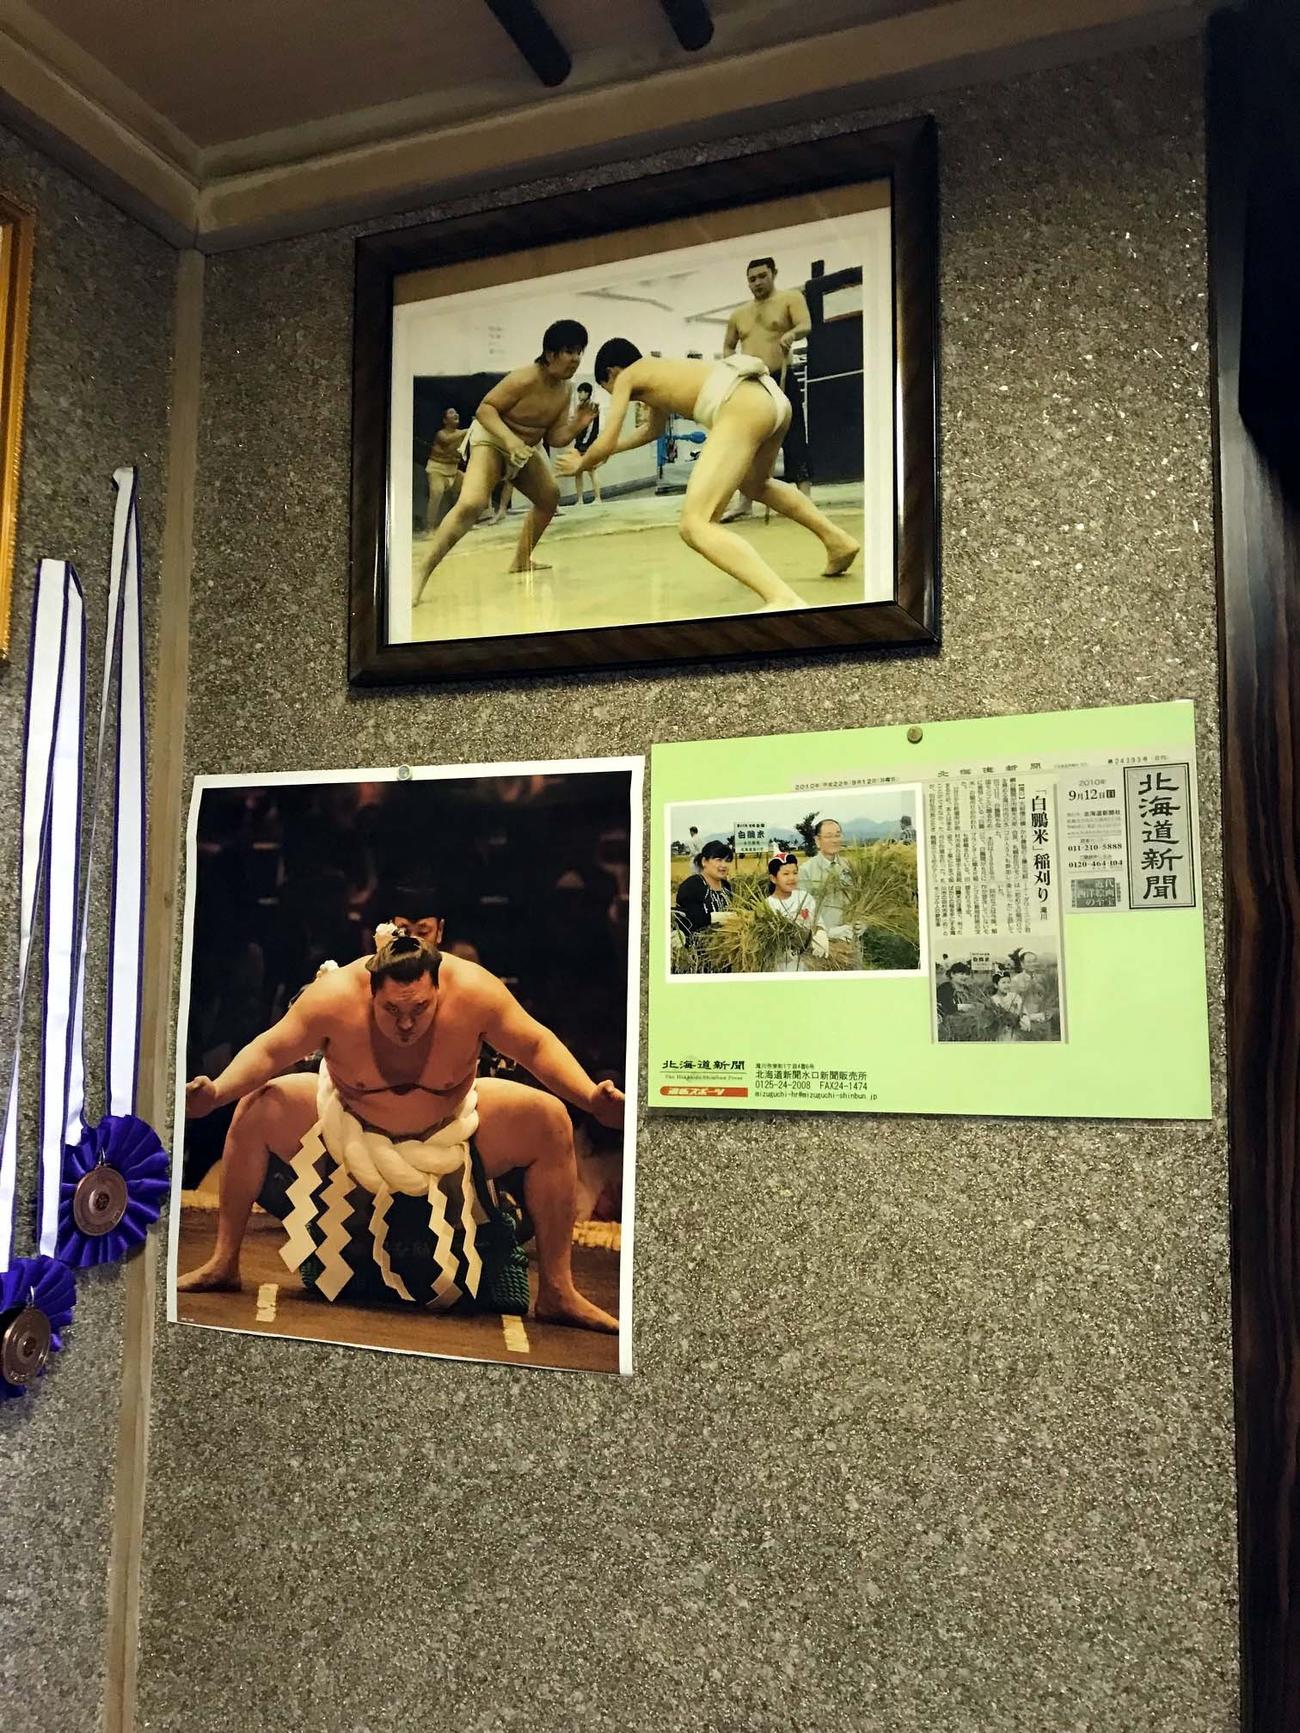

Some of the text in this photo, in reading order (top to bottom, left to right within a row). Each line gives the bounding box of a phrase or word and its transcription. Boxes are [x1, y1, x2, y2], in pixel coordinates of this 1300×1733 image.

[1138, 772, 1183, 900] 北海道新聞
[662, 1060, 745, 1070] 北海道新聞
[755, 1080, 868, 1091] 0125-24-2008 FAX24-1474
